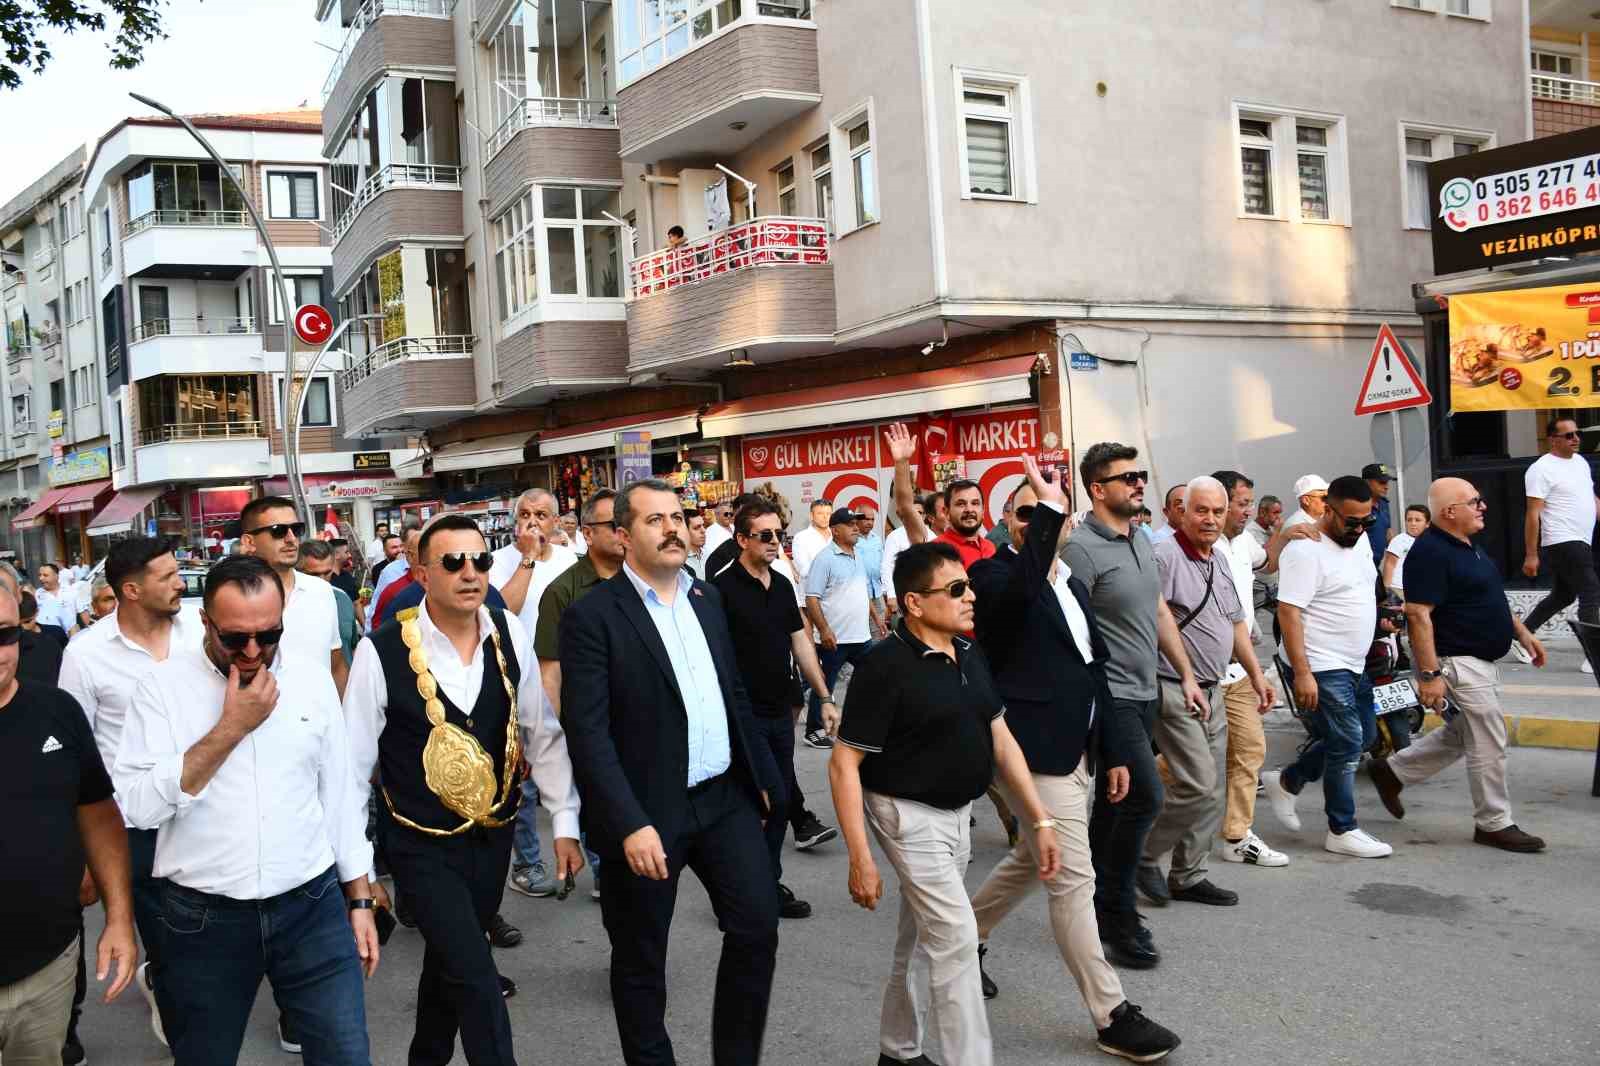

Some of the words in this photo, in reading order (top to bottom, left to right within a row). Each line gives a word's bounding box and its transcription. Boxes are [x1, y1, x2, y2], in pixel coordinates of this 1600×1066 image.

[1476, 182, 1487, 200] 0
[1494, 173, 1530, 196] 505
[1537, 164, 1574, 188] 277
[1478, 204, 1489, 221] 0
[1496, 195, 1532, 218] 362
[1539, 187, 1577, 211] 646
[1585, 182, 1600, 201] 4
[1481, 223, 1600, 256] VEZİRKÖPR
[1547, 366, 1580, 395] 2.
[774, 440, 803, 470] GÜL
[807, 435, 872, 467] MARKET
[959, 418, 1039, 453] MARKET
[342, 487, 378, 497] DONDURMA
